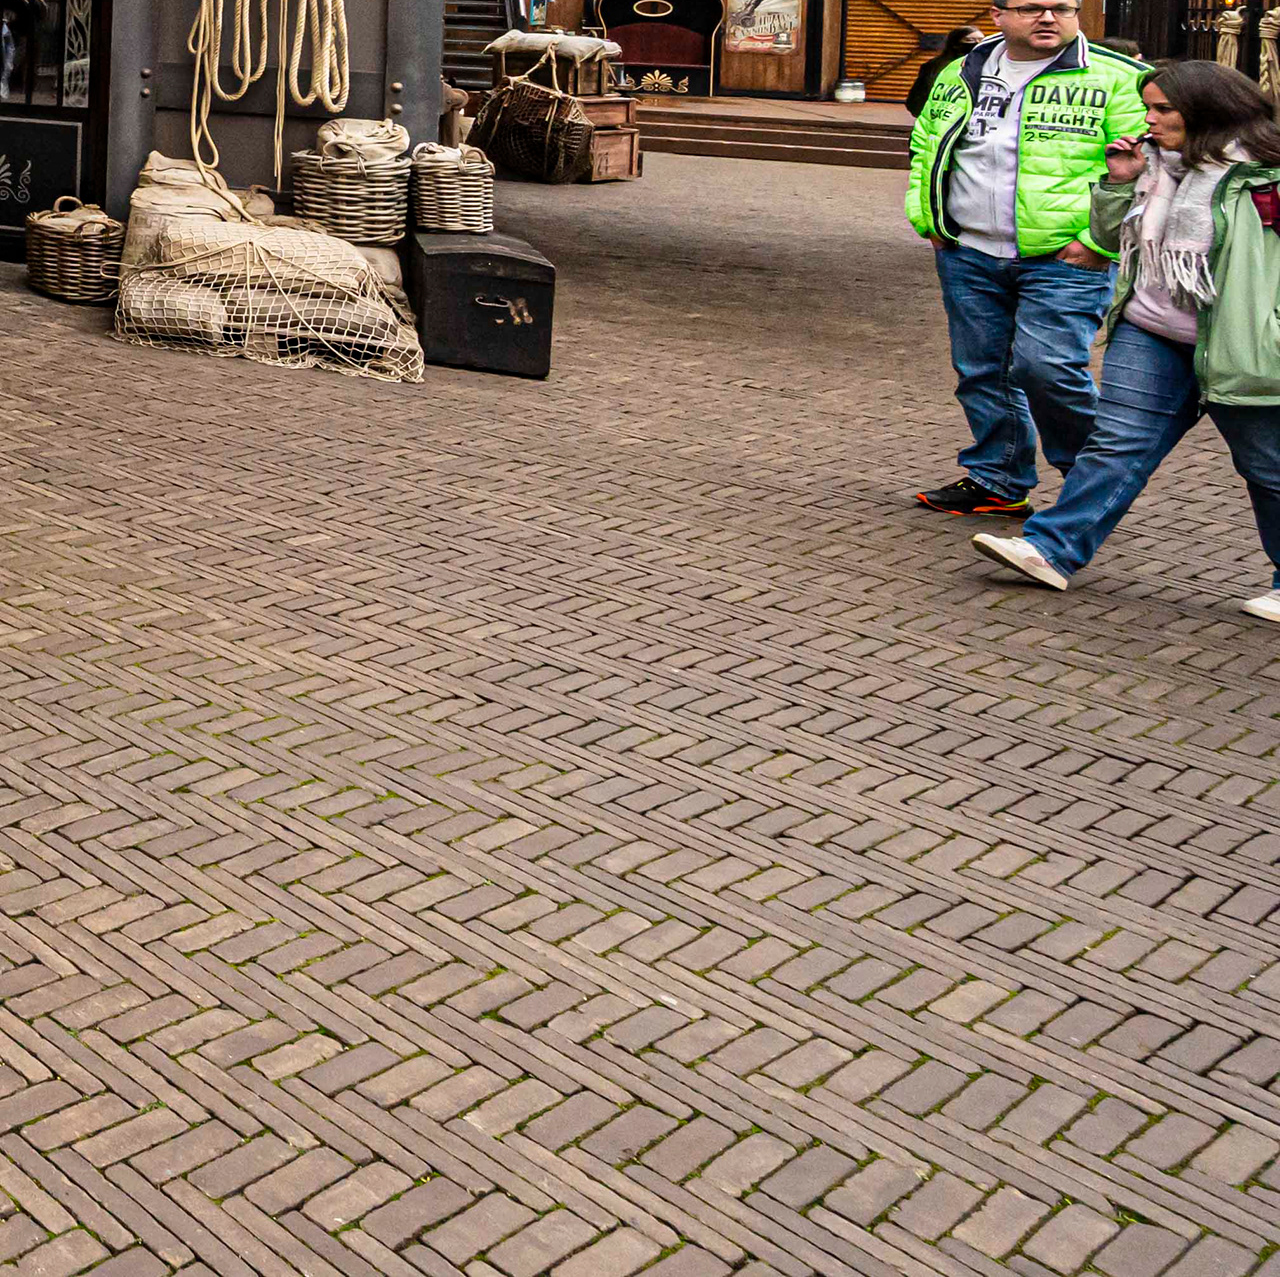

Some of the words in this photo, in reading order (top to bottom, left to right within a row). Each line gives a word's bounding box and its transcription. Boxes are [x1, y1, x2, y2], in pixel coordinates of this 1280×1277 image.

[1031, 85, 1107, 108] DAVID
[1043, 105, 1100, 116] FUTURE
[1026, 112, 1101, 128] FLIGHT
